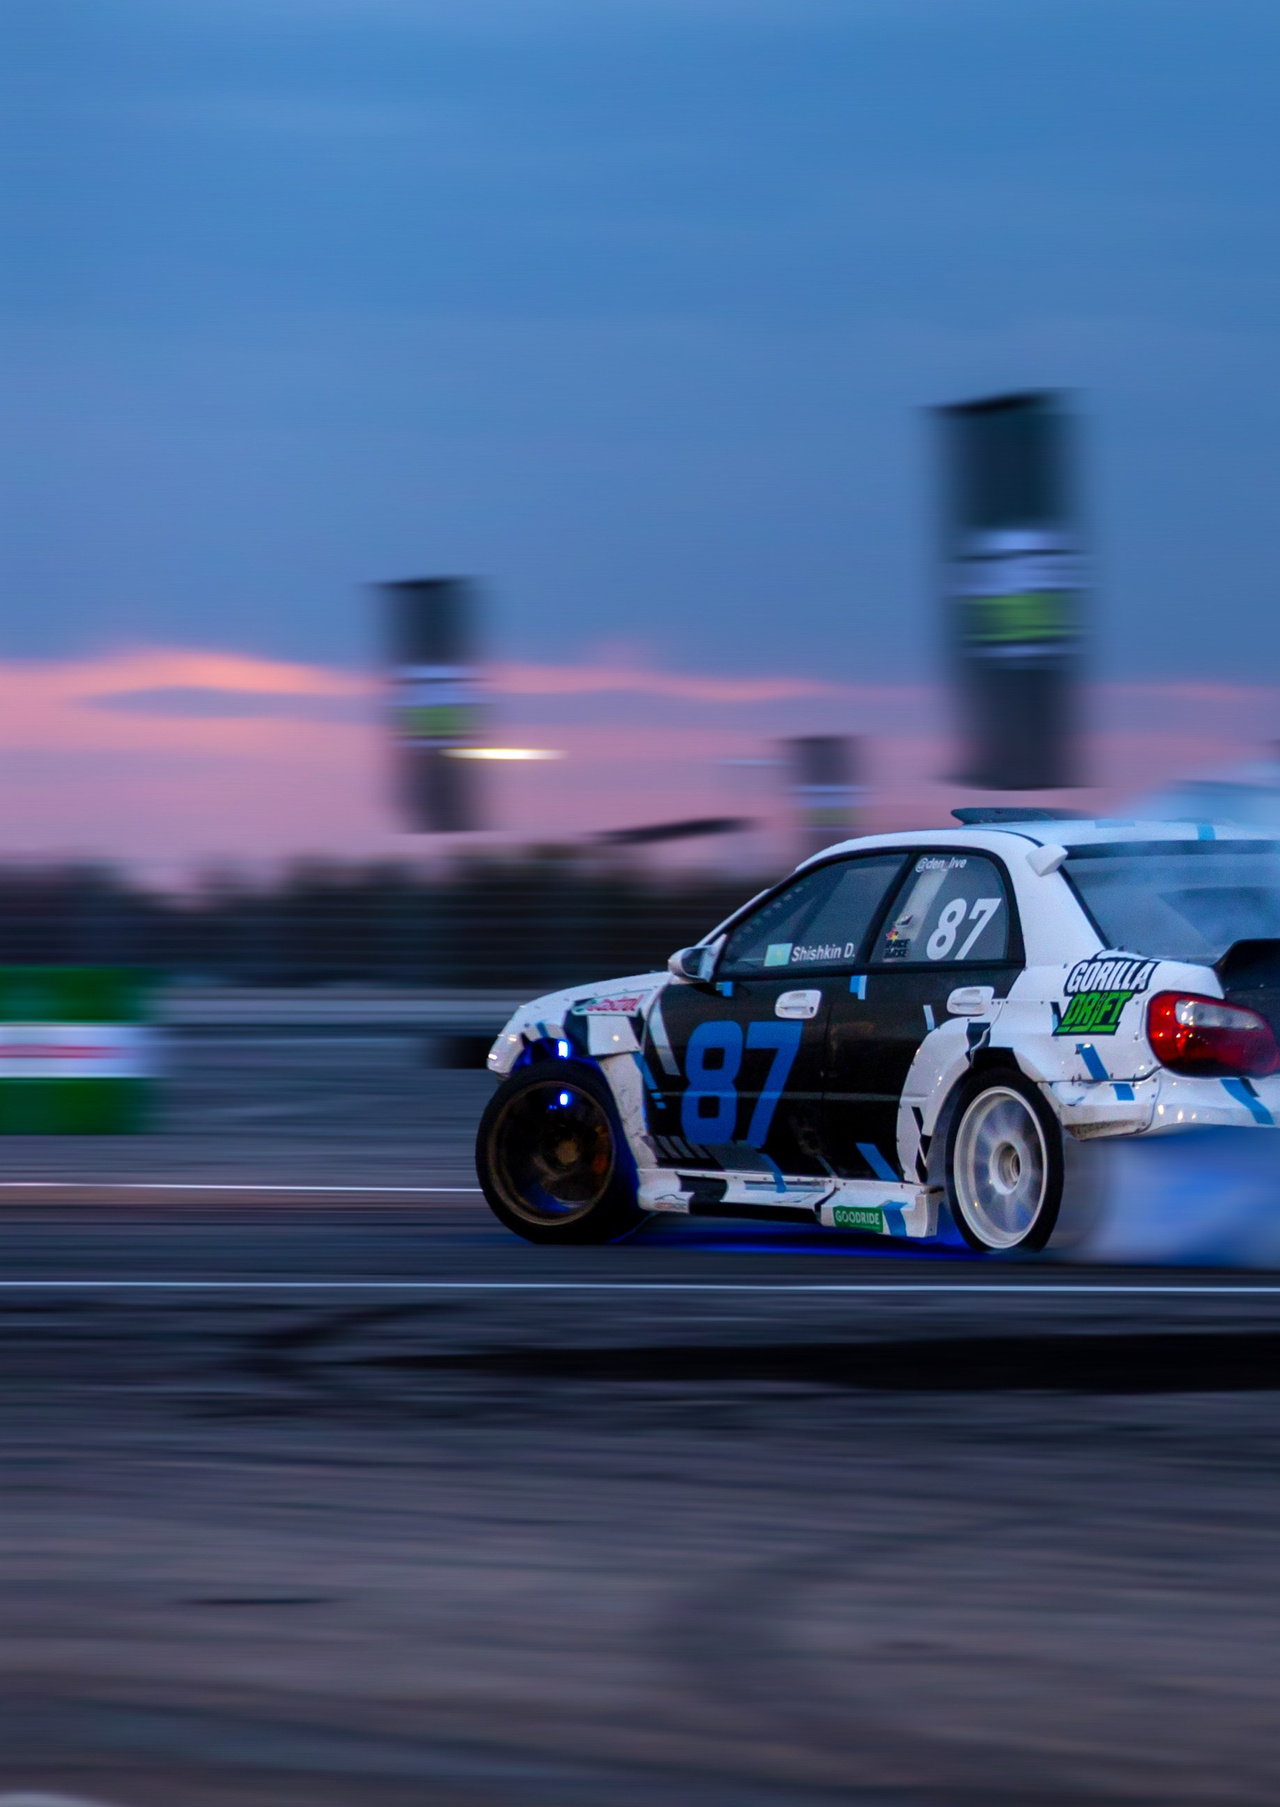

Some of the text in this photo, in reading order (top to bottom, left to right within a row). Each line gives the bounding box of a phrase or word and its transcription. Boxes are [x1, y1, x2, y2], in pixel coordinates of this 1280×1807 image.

[926, 898, 1002, 960] 87
[791, 942, 855, 962] Shishkin D.
[1066, 961, 1156, 993] GORILLA
[1056, 991, 1133, 1033] DRIFT
[681, 1020, 804, 1149] 87
[835, 1210, 881, 1225] GOODRIDE
